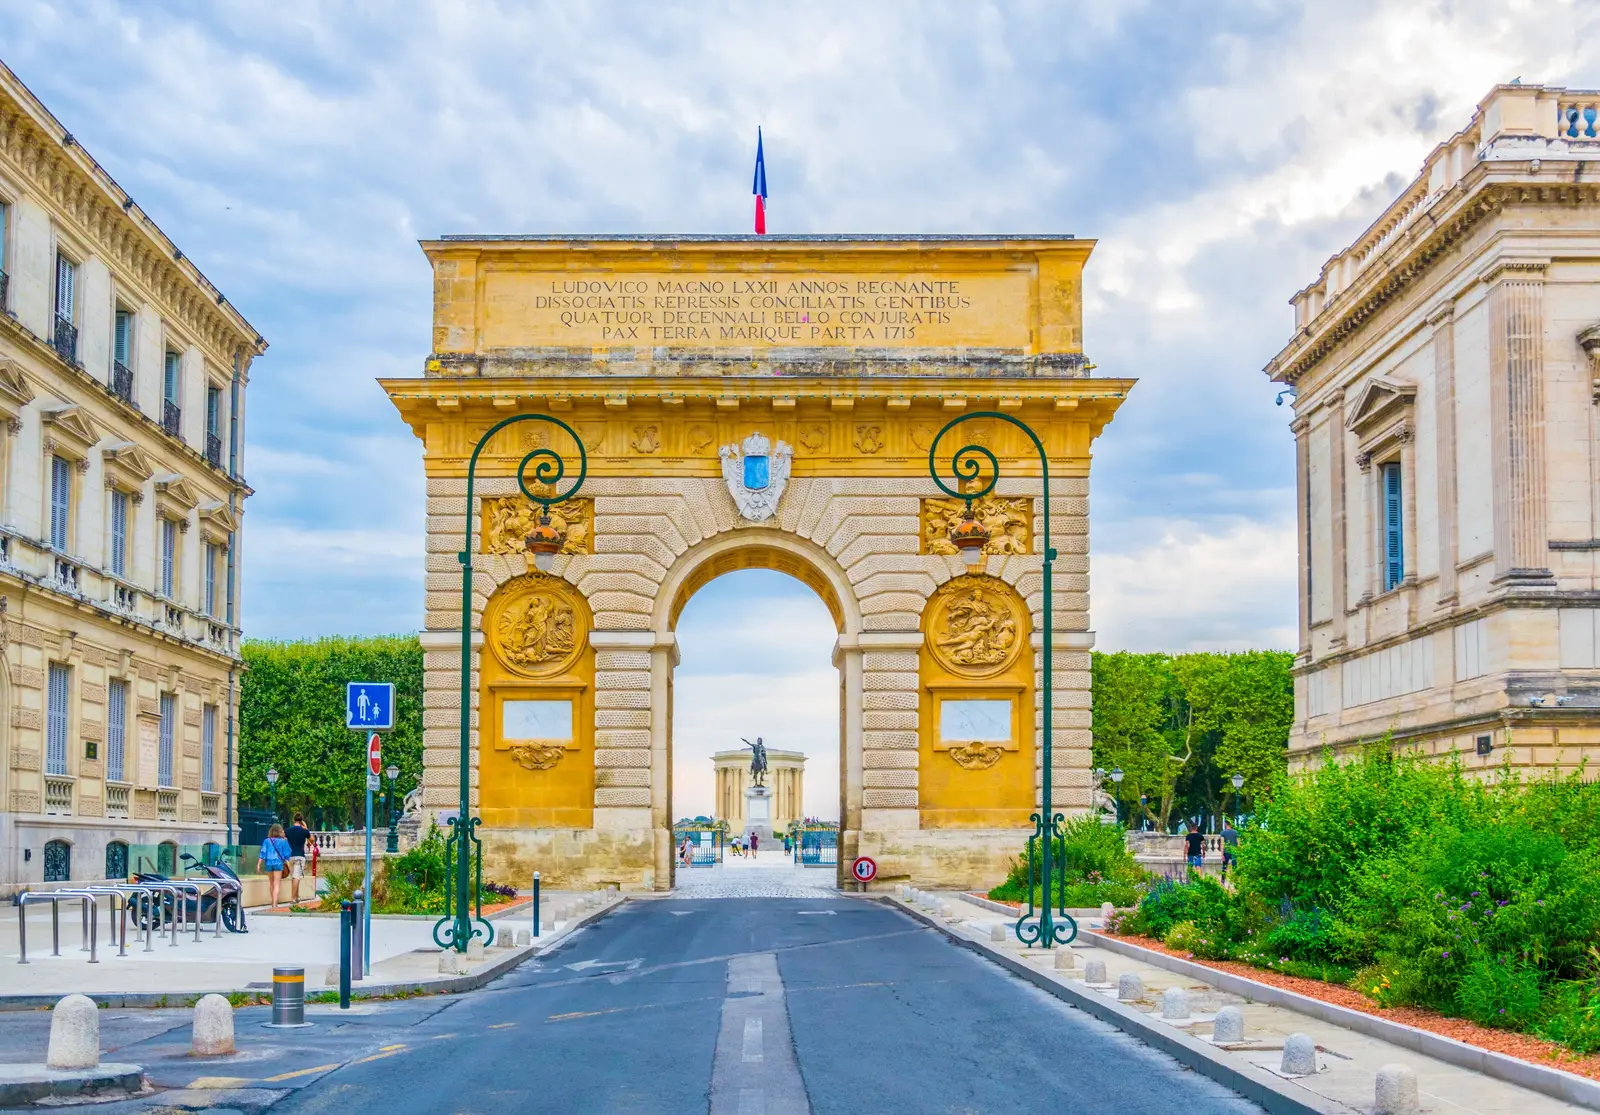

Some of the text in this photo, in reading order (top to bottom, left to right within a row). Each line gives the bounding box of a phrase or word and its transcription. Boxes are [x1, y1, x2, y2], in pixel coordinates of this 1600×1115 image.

[552, 281, 960, 294] LUDOVICO MAGNO LXXII ANNOS REGNANTE
[536, 296, 970, 309] DISSOCIATIS REPRESSIS CONCILIATIS GENTIBUS
[560, 311, 951, 327] QUATUOR DECENNALI BELLO CONJURATIS
[602, 326, 917, 342] PAX TERRA MARIQUE PARTA 1715
